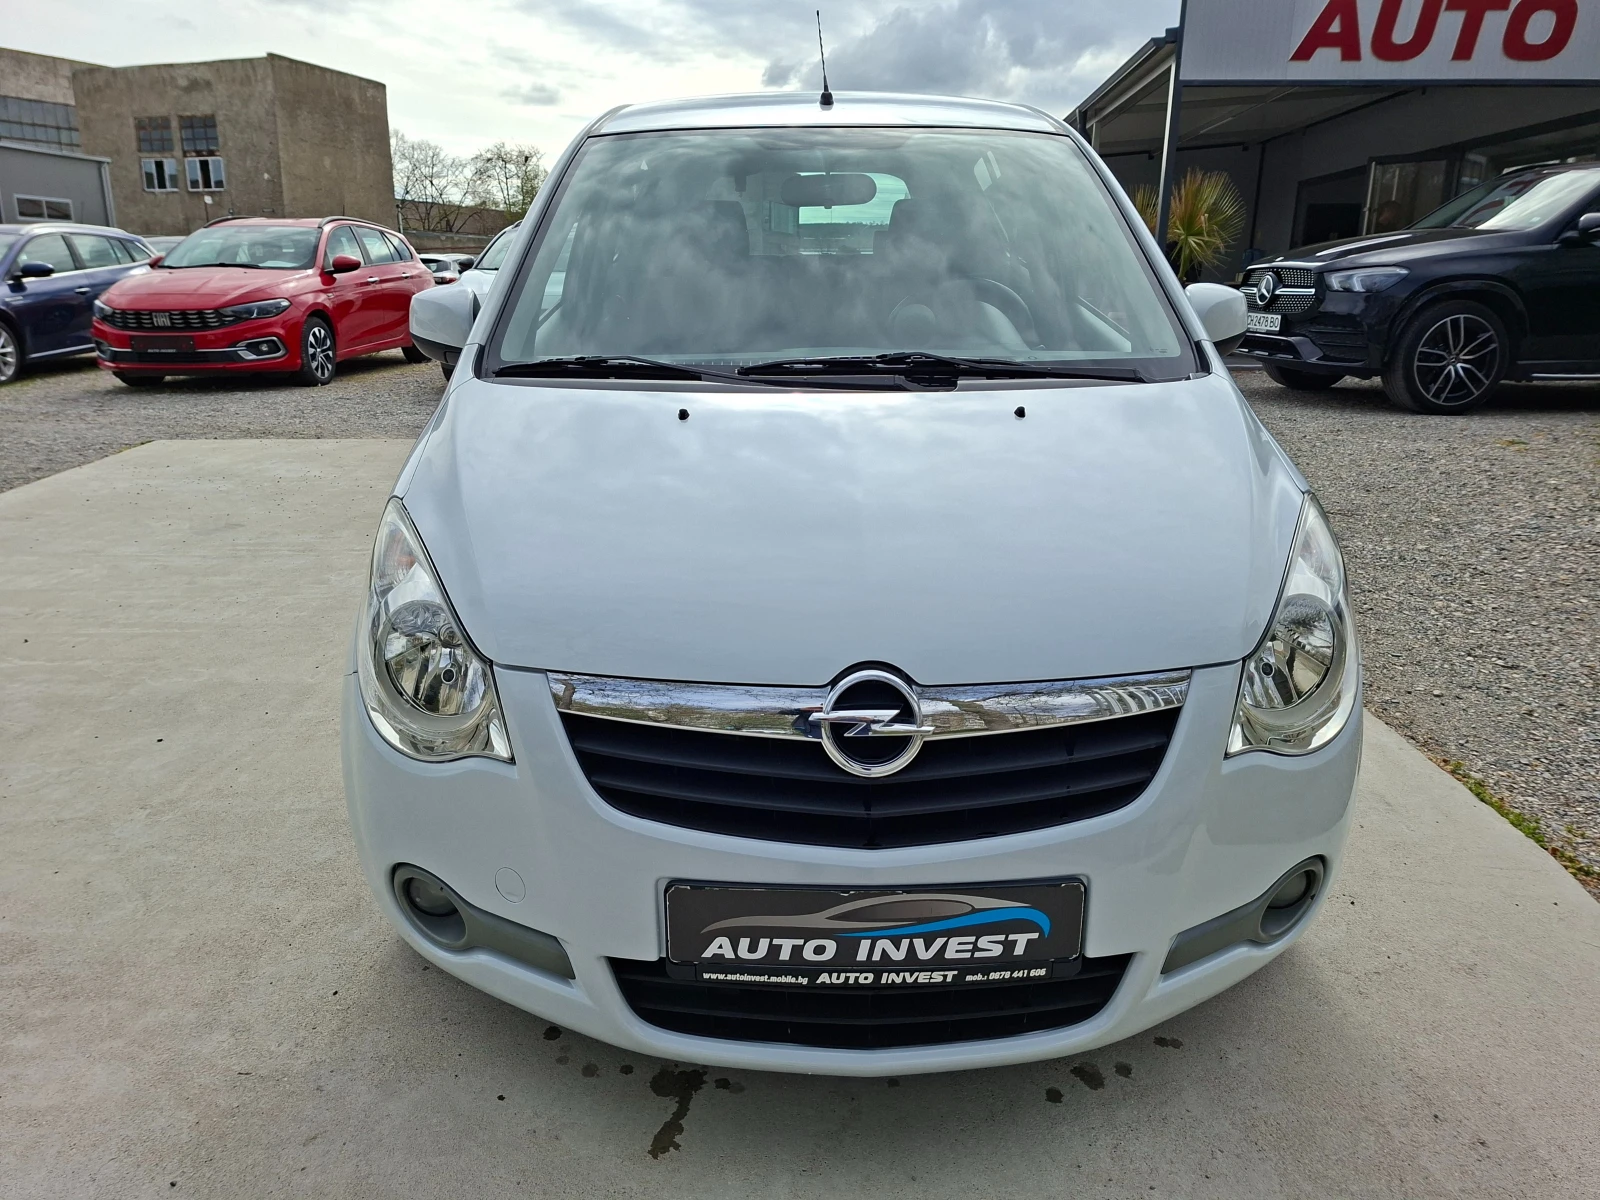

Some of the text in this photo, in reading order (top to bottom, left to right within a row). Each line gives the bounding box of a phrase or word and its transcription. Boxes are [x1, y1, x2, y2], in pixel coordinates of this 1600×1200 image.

[1288, 0, 1578, 62] AUTO
[152, 312, 171, 326] FIAT
[700, 932, 1040, 961] AUTO INVEST
[702, 972, 808, 985] www.autoinvest.mobile.bg
[815, 972, 874, 984] AUTO
[880, 970, 958, 984] INVEST
[988, 971, 1011, 980] 0878
[1011, 969, 1028, 978] 441
